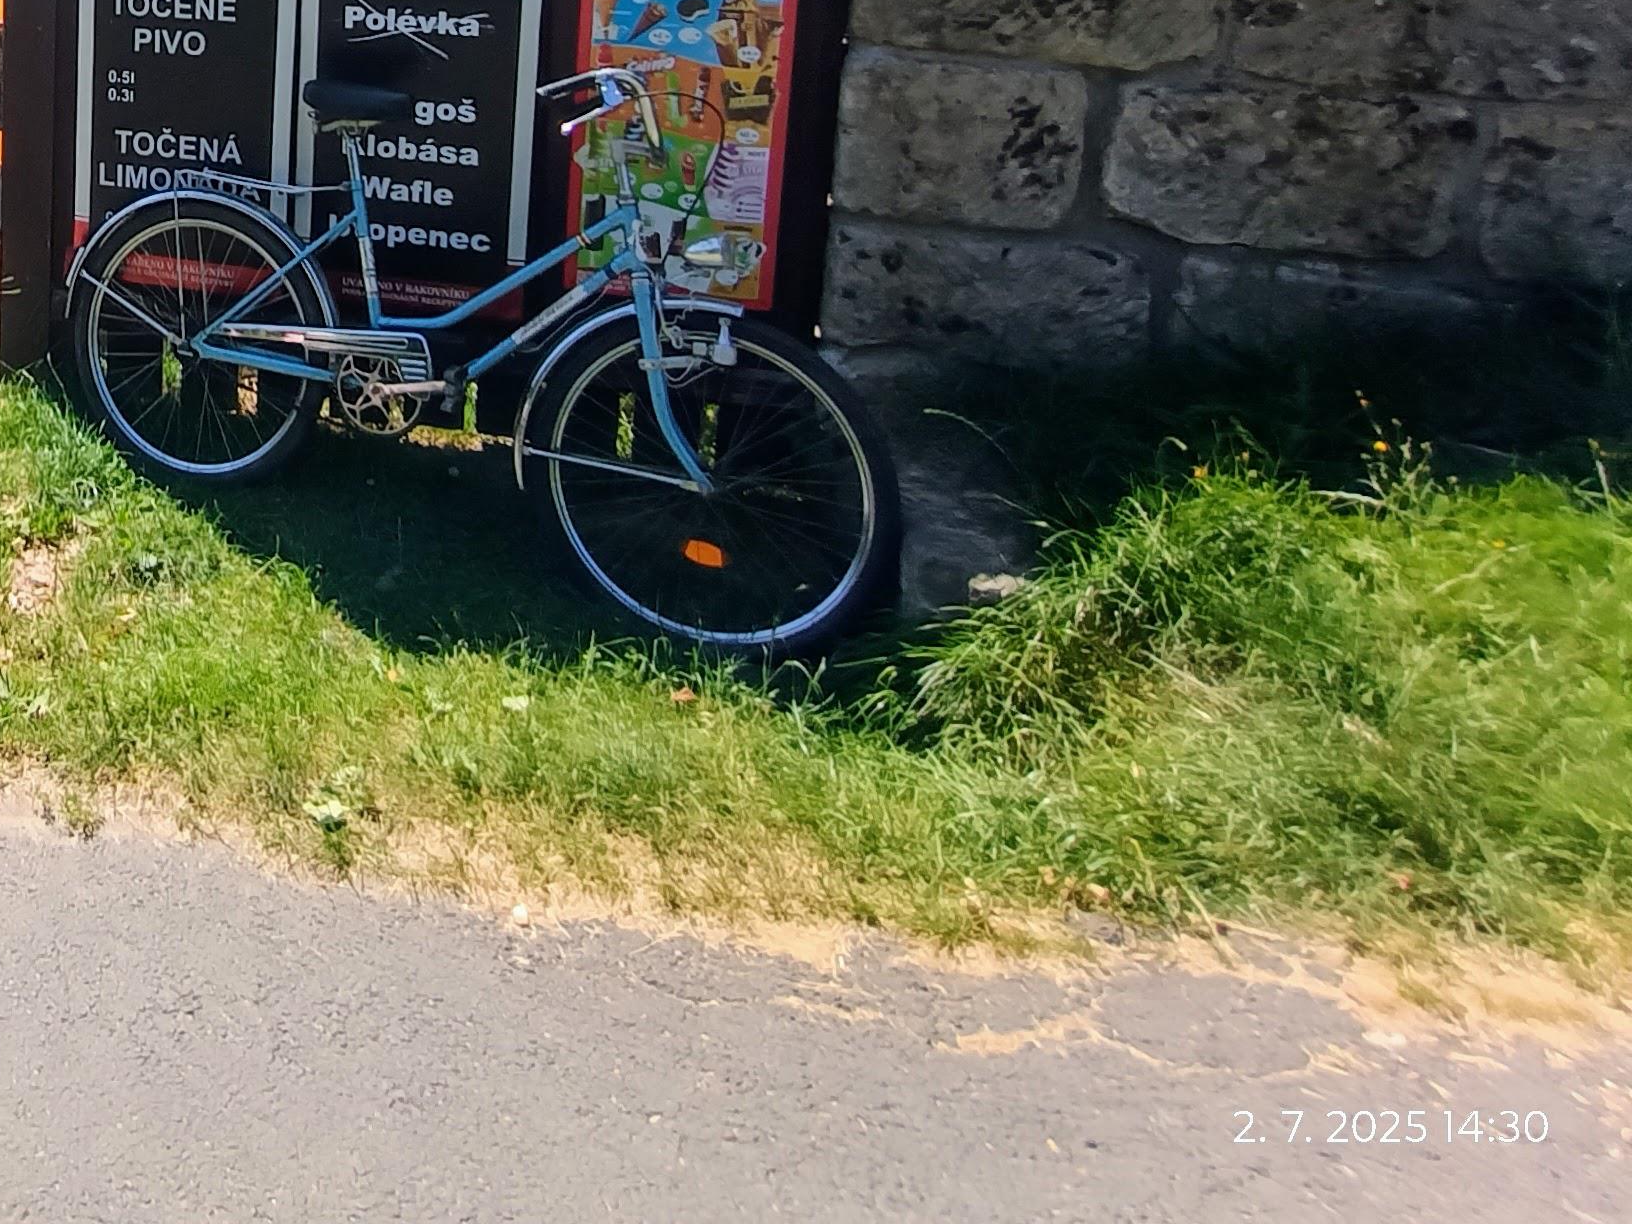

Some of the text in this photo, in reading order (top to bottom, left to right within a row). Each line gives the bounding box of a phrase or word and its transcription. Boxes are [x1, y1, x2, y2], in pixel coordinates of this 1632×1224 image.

[344, 5, 480, 37] Polévka
[134, 27, 206, 56] PIVO
[114, 127, 243, 166] TOČENÁ
[361, 174, 455, 206] Wafle
[329, 213, 491, 253] openec
